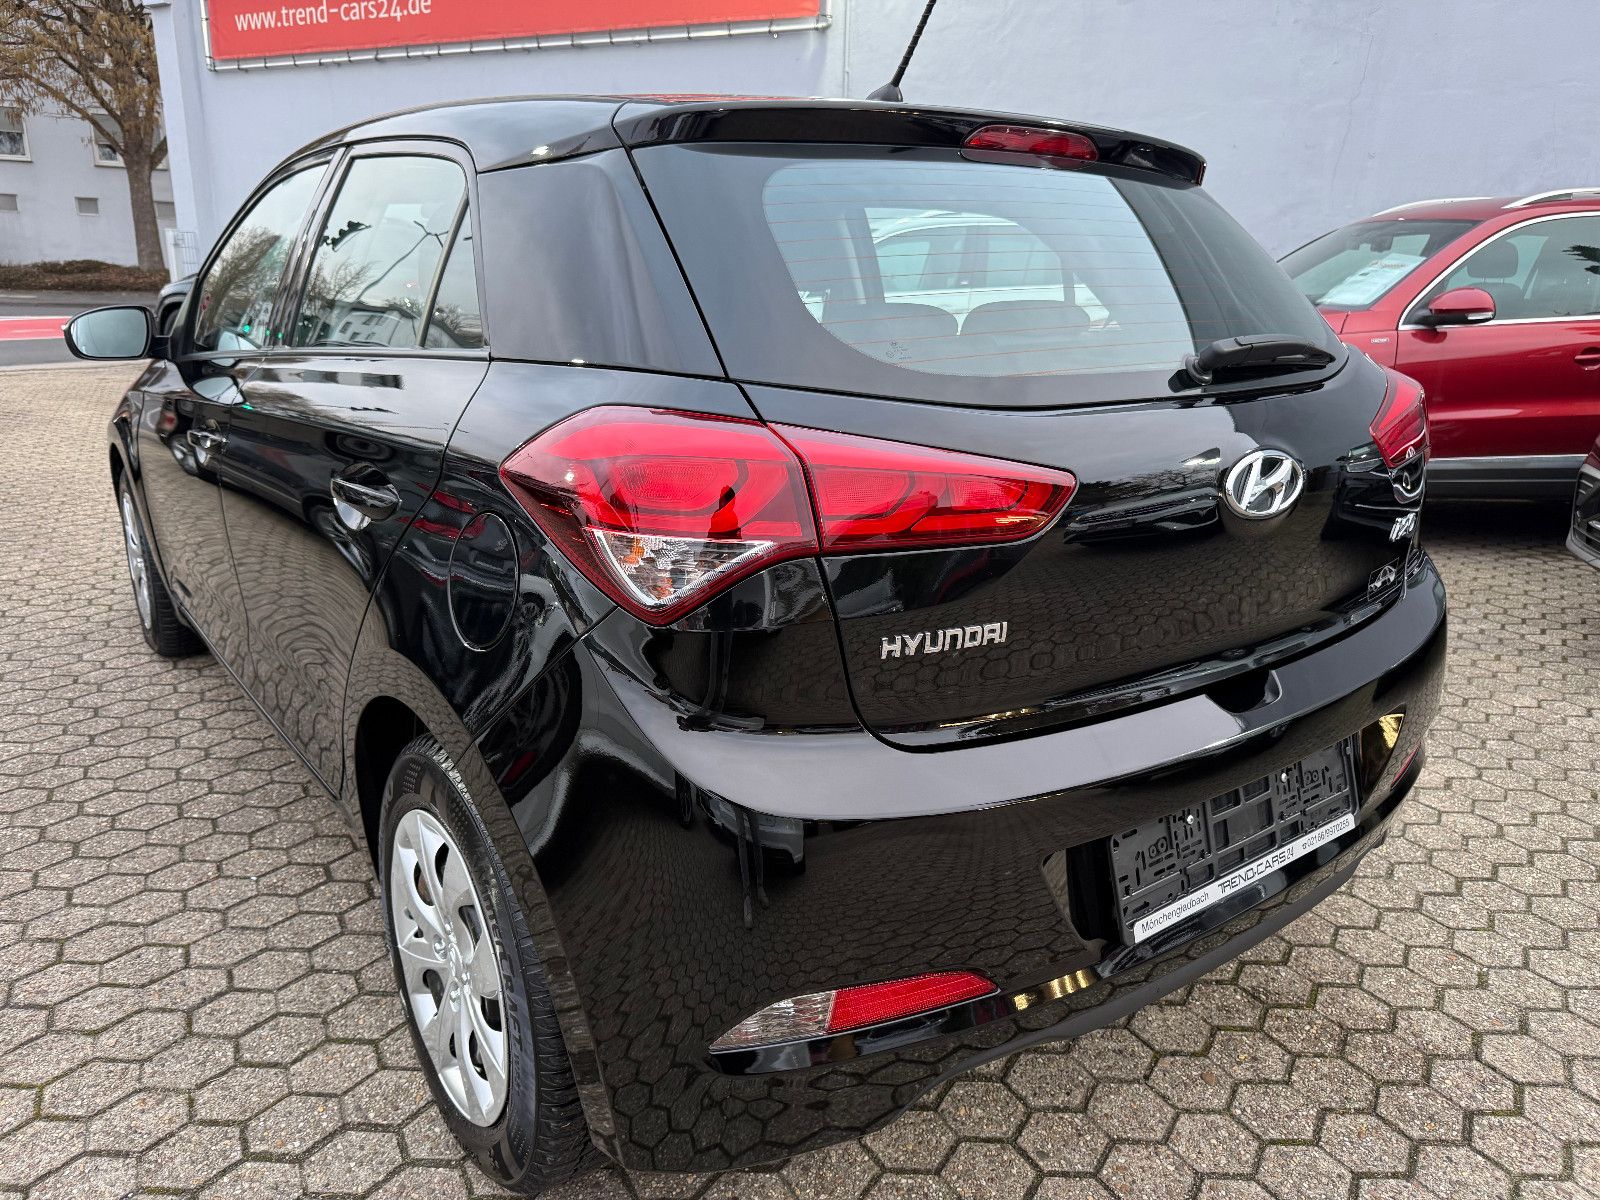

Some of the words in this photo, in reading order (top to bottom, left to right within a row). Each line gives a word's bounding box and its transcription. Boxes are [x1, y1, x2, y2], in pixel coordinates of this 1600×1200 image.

[235, 0, 431, 31] www.trend-cars24.de
[880, 621, 1008, 660] HYUNDAI
[1141, 891, 1210, 934] Mönchengladbach
